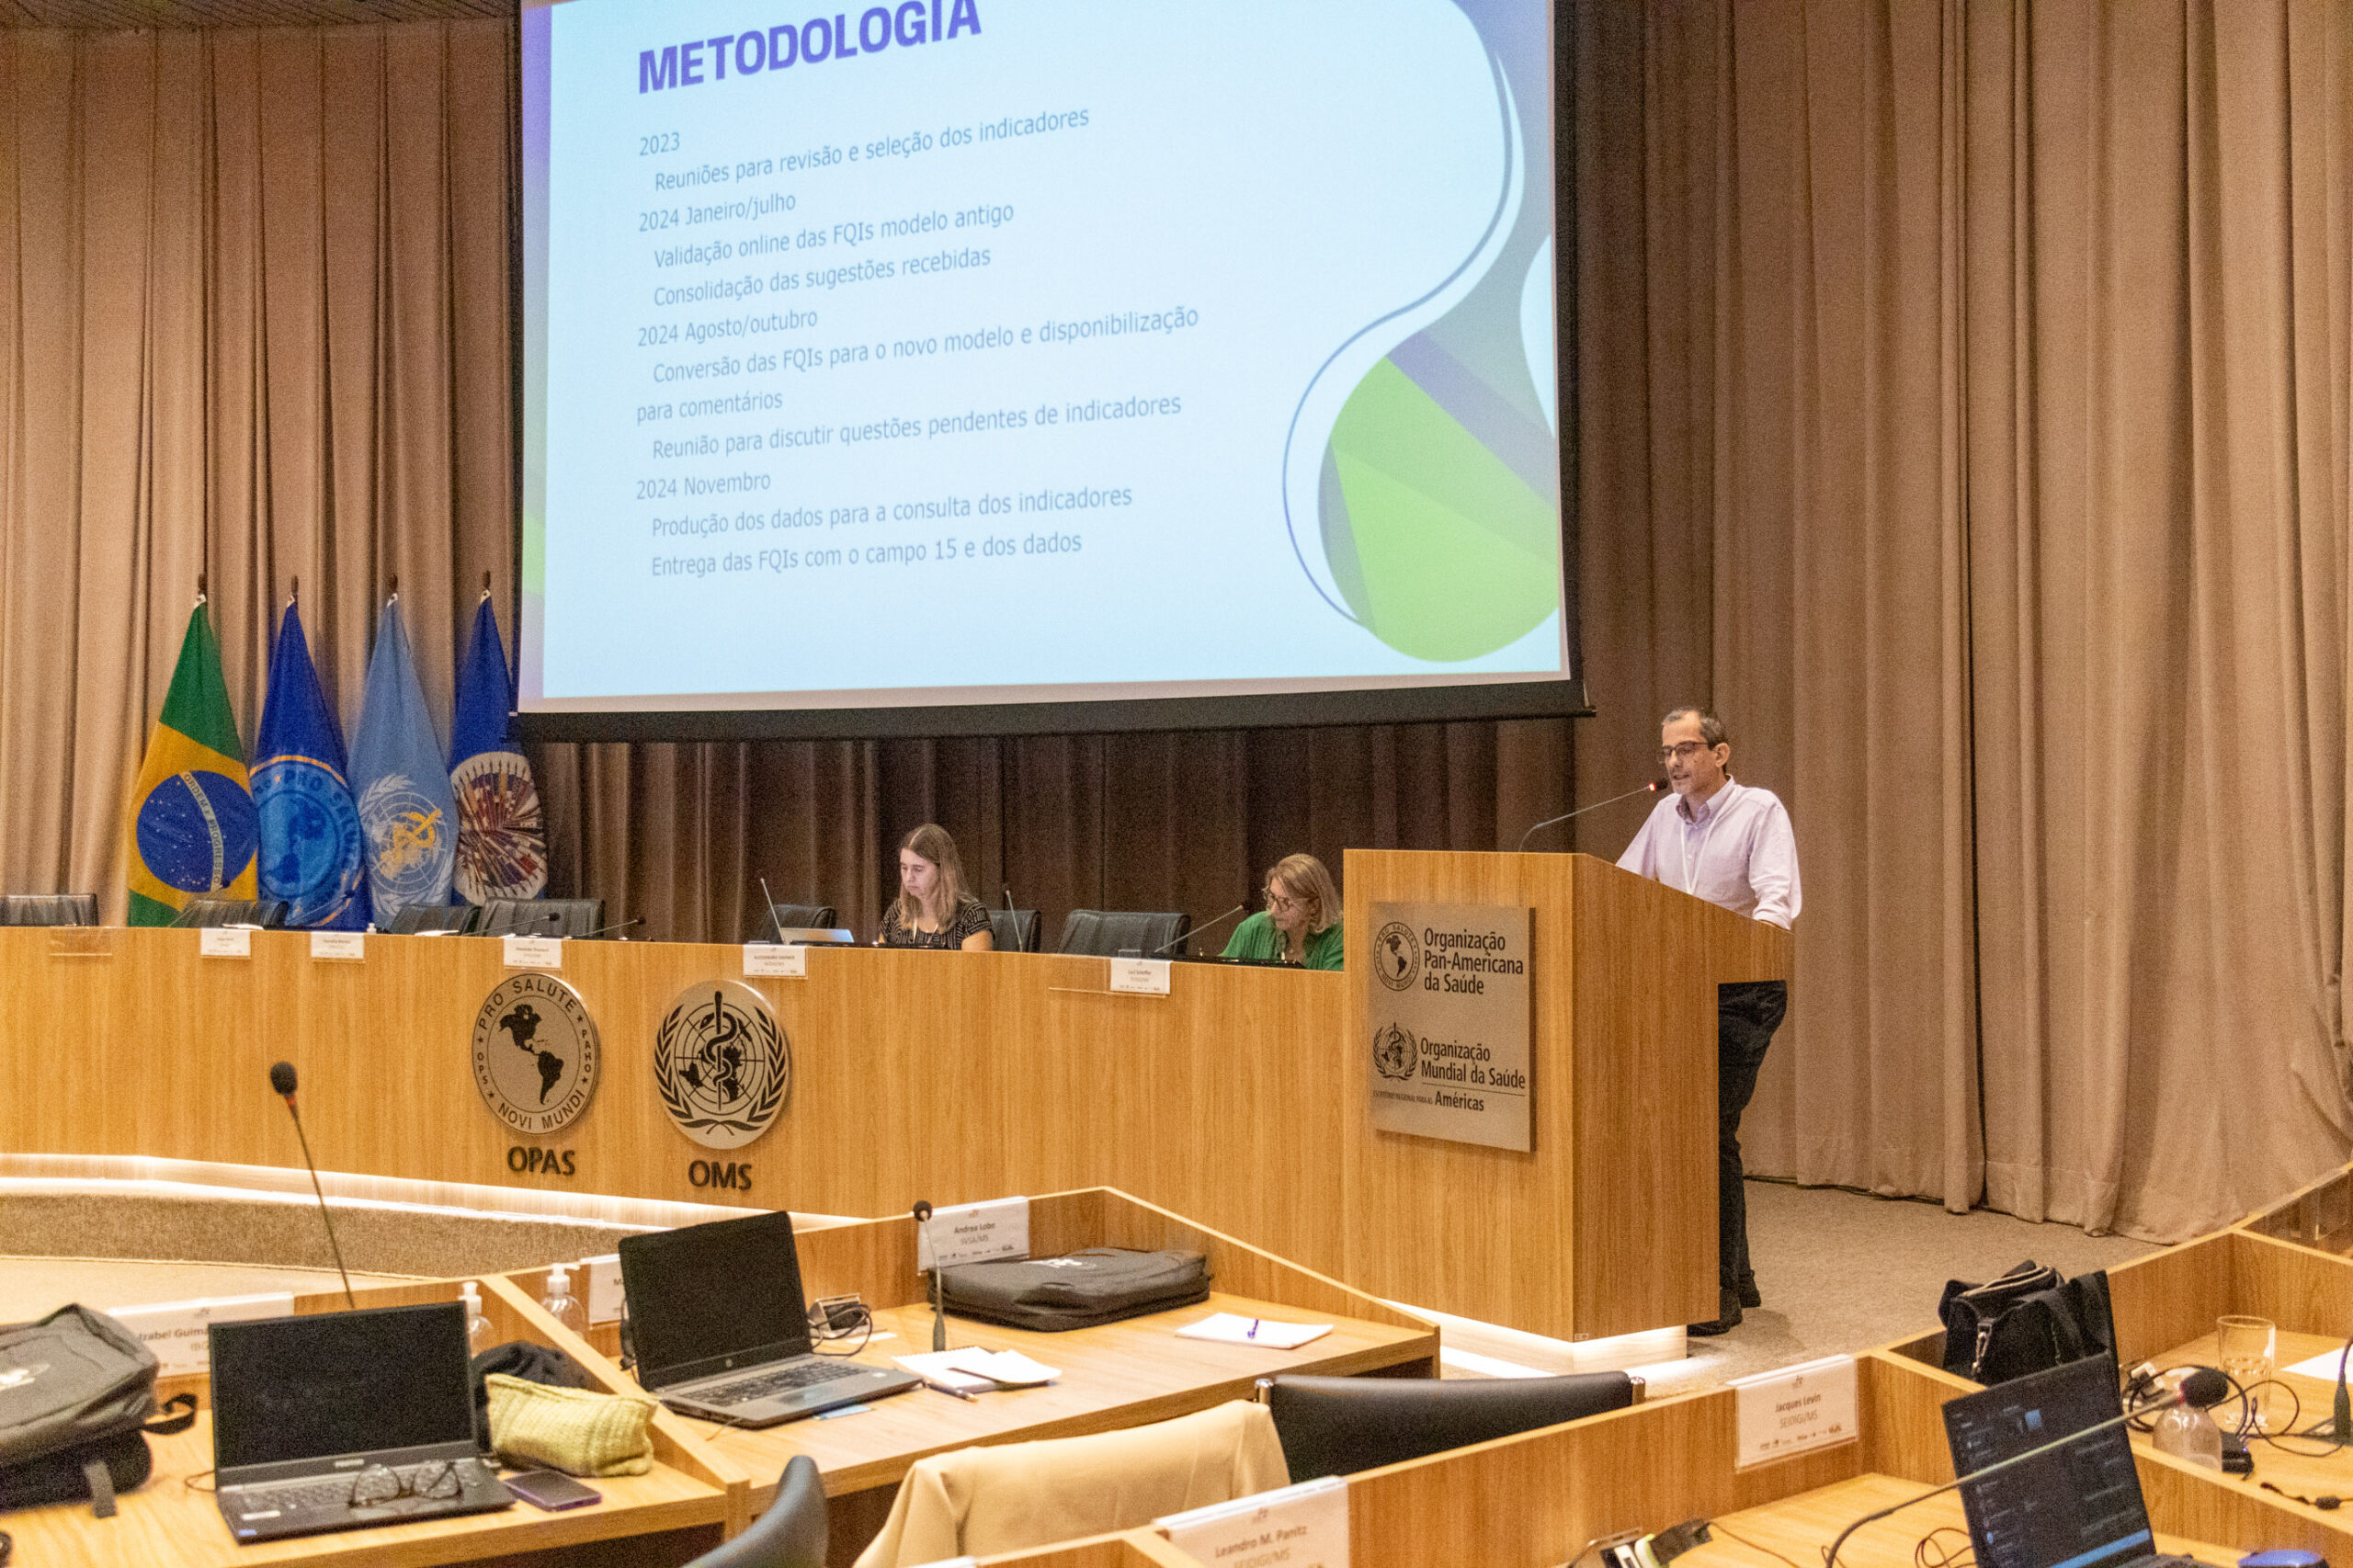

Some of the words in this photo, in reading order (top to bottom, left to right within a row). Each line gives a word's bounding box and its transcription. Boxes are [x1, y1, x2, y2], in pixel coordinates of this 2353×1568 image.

[639, 0, 982, 93] METODOLOGIA
[640, 131, 679, 156] 2023
[655, 165, 729, 190] Reuniões
[736, 159, 772, 183] para
[780, 145, 842, 171] revisão
[848, 146, 858, 162] e
[866, 131, 933, 159] seleção
[939, 127, 972, 148] dos
[980, 109, 1089, 142] indicadores
[640, 209, 679, 232] 2024
[687, 193, 796, 224] Janeiro/julho
[654, 241, 732, 267] Validação
[738, 235, 790, 256] online
[796, 229, 826, 249] das
[834, 222, 874, 246] FQIs
[881, 211, 948, 237] modelo
[955, 205, 1014, 237] antigo
[654, 276, 763, 305] Consolidação
[770, 269, 799, 291] das
[806, 259, 895, 290] sugestões
[903, 248, 991, 275] recebidas
[638, 324, 678, 347] 2024
[686, 310, 817, 344] Agosto/outubro
[654, 357, 740, 382] Conversão
[747, 354, 776, 372] das
[783, 347, 823, 372] FQIs
[830, 346, 869, 368] para
[875, 344, 886, 359] o
[893, 338, 937, 357] novo
[945, 326, 1014, 351] modelo
[1021, 328, 1032, 344] e
[1040, 306, 1199, 344] disponibilização
[638, 404, 672, 424] para
[679, 392, 782, 417] comentários
[654, 436, 719, 458] Reunião
[726, 435, 762, 455] para
[769, 427, 833, 449] discutir
[840, 417, 921, 445] questões
[929, 410, 1028, 438] pendentes
[1035, 404, 1058, 425] de
[1066, 396, 1181, 422] indicadores
[637, 479, 676, 499] 2024
[685, 472, 770, 494] Novembro
[654, 514, 728, 538] Produção
[735, 512, 764, 530] dos
[771, 507, 823, 528] dados
[830, 505, 869, 528] para
[876, 506, 885, 521] a
[894, 497, 970, 520] consulta
[979, 494, 1011, 515] dos
[1019, 487, 1132, 511] indicadores
[653, 553, 716, 576] Entrega
[723, 553, 752, 571] das
[759, 550, 798, 573] FQIs
[805, 550, 841, 566] com
[849, 549, 858, 564] o
[867, 545, 926, 564] campo
[937, 539, 956, 560] 15
[965, 541, 975, 557] e
[983, 536, 1016, 556] dos
[1024, 532, 1082, 554] dados
[1424, 927, 1506, 955] Organização
[1424, 949, 1524, 975] Pan-Americana
[1424, 974, 1440, 992] da
[1444, 974, 1484, 994] Saúde
[479, 993, 504, 1030] PRO
[513, 978, 577, 1013] SALUTE
[476, 1051, 488, 1085] OPS
[581, 1028, 593, 1074] PAHO
[1420, 1036, 1491, 1066] Organização
[1421, 1061, 1468, 1084] Mundial
[1471, 1063, 1485, 1085] da
[1489, 1068, 1526, 1089] Saúde
[498, 1102, 533, 1131] NOVI
[540, 1088, 586, 1130] MUNDI
[1435, 1090, 1484, 1111] Américas
[507, 1145, 575, 1176] OPAS
[688, 1160, 752, 1191] OMS
[1776, 1399, 1802, 1413] Jacques
